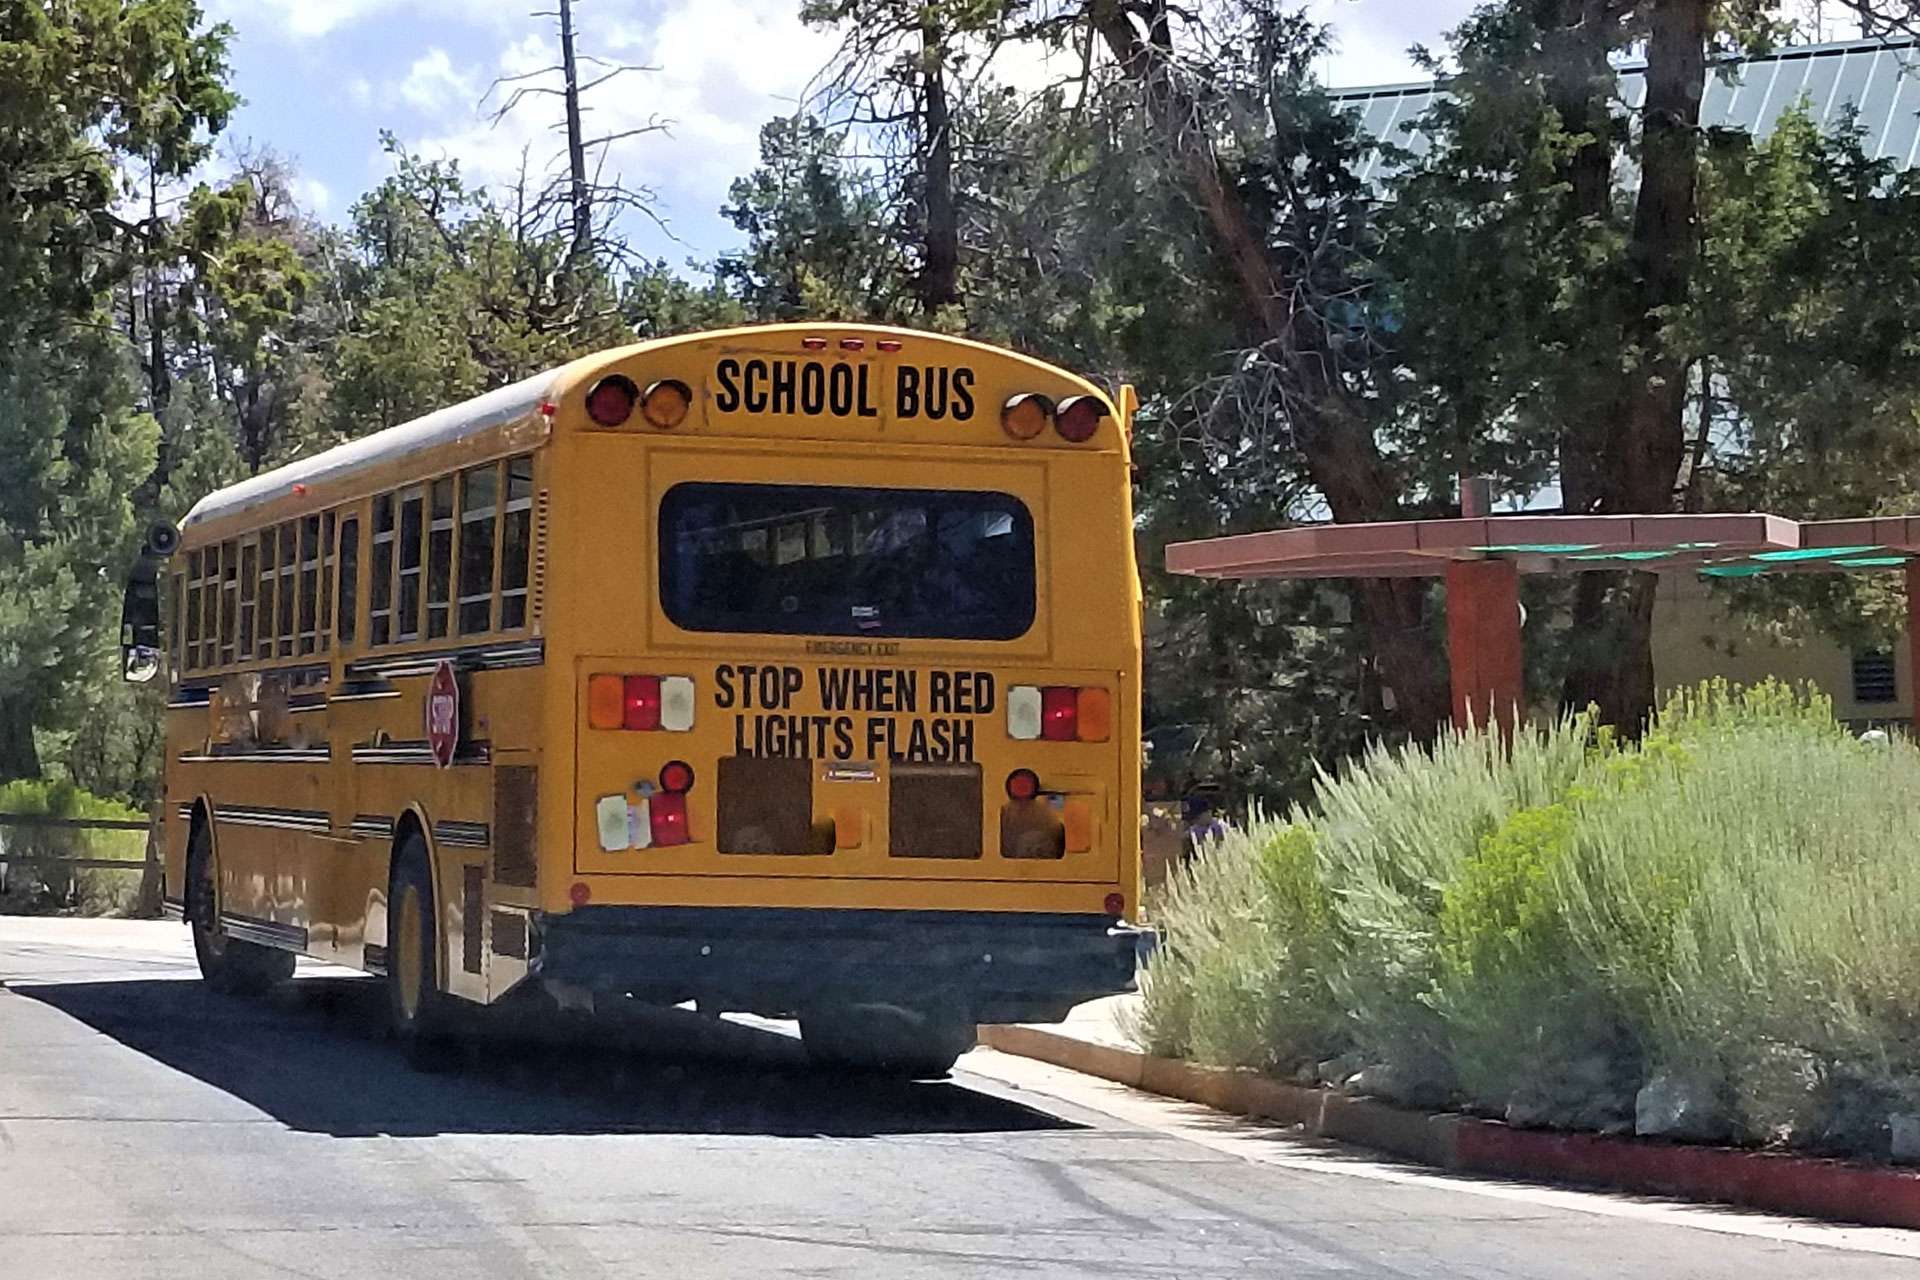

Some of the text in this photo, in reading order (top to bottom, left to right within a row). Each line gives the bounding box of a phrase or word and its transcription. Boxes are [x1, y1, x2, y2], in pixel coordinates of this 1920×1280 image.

[716, 359, 975, 421] SCHOOL BUS
[714, 664, 995, 714] STOP WHEN RED
[735, 714, 974, 762] LIGHTS FLASH
